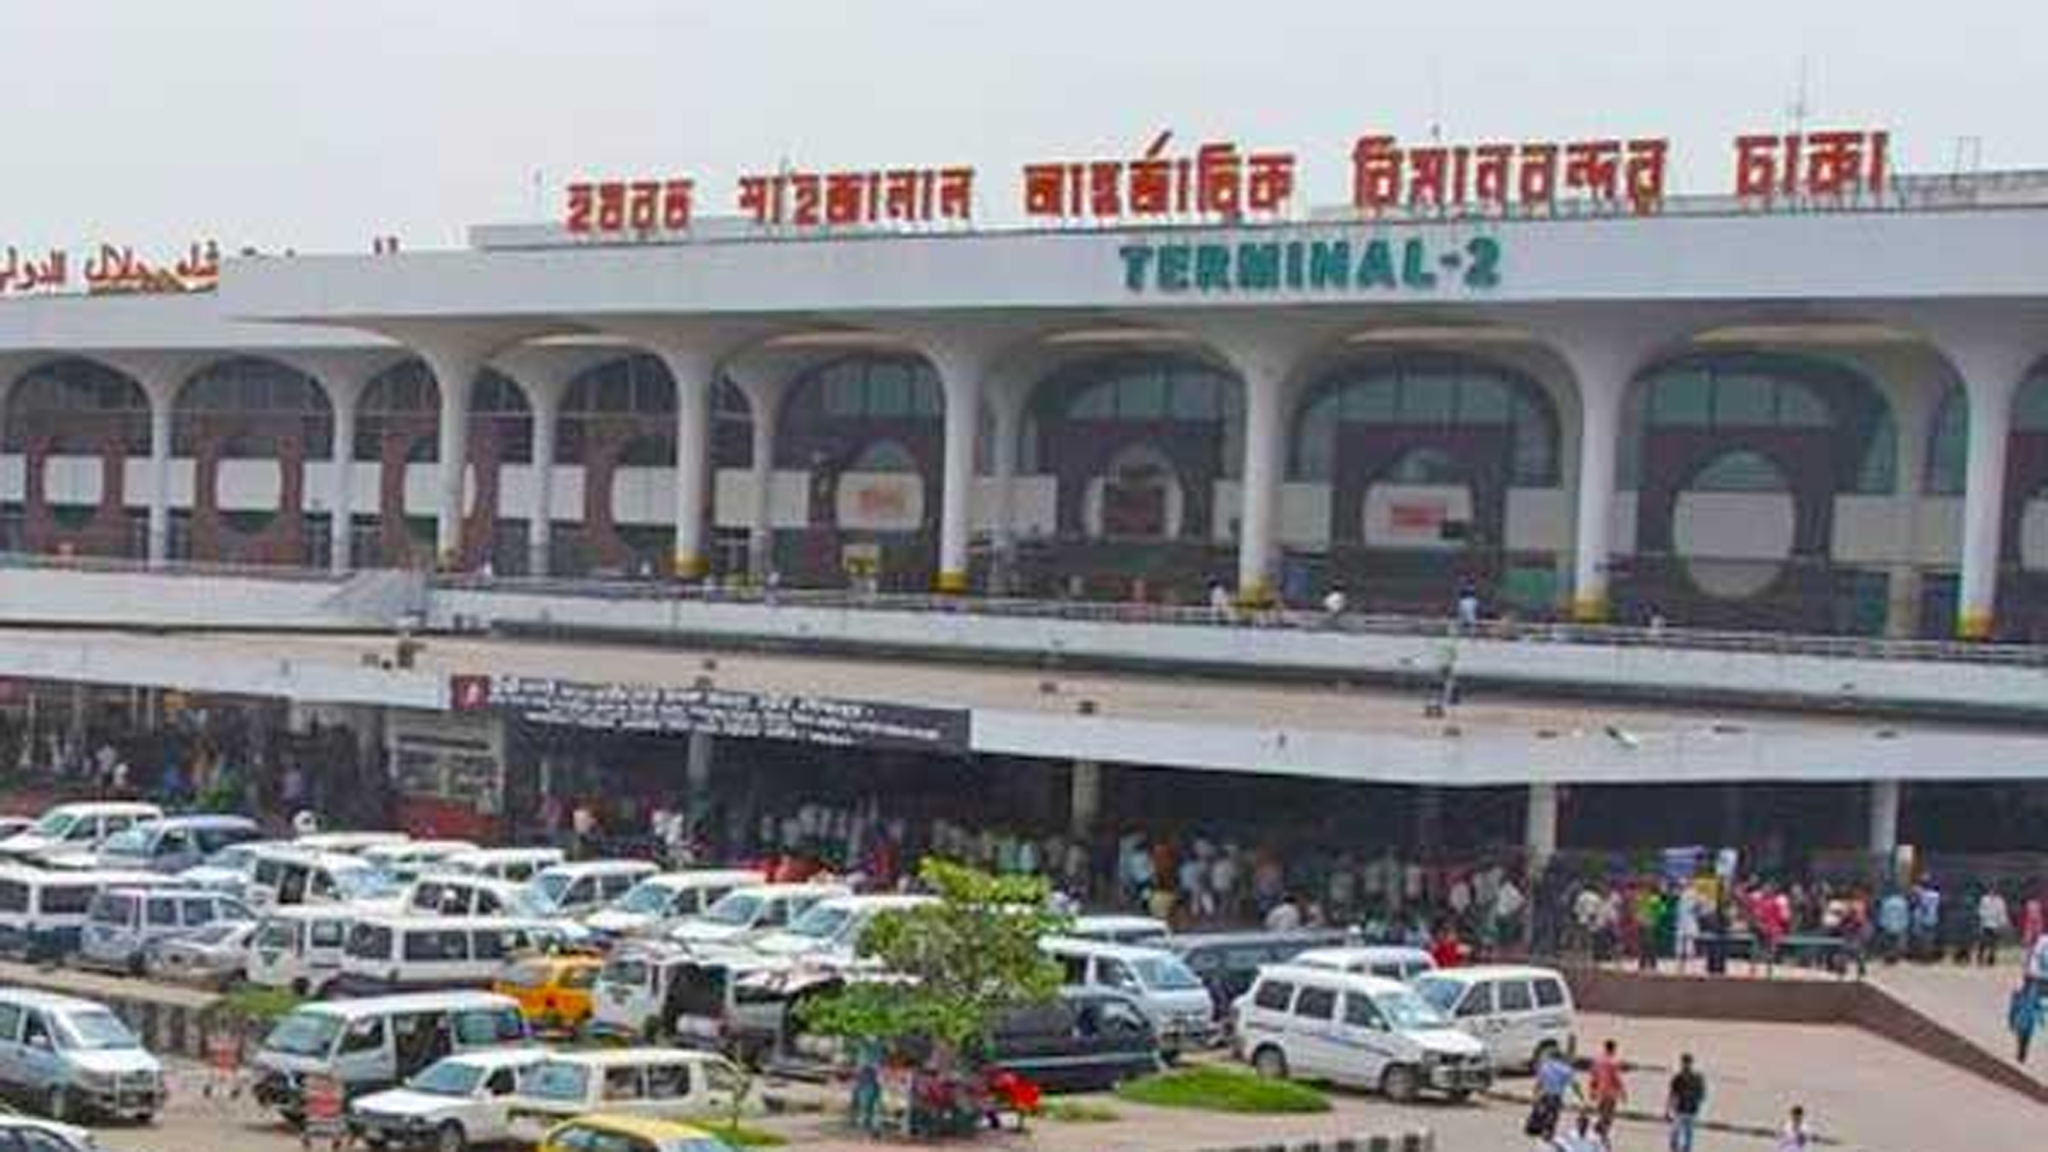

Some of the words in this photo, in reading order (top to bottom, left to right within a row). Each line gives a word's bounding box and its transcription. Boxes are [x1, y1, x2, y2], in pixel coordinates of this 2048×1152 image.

[566, 178, 691, 232] হযরত
[738, 166, 973, 227] শাহজালাল
[1735, 131, 1889, 200] ঢাকা
[1119, 237, 1501, 293] TERMINAL-2
